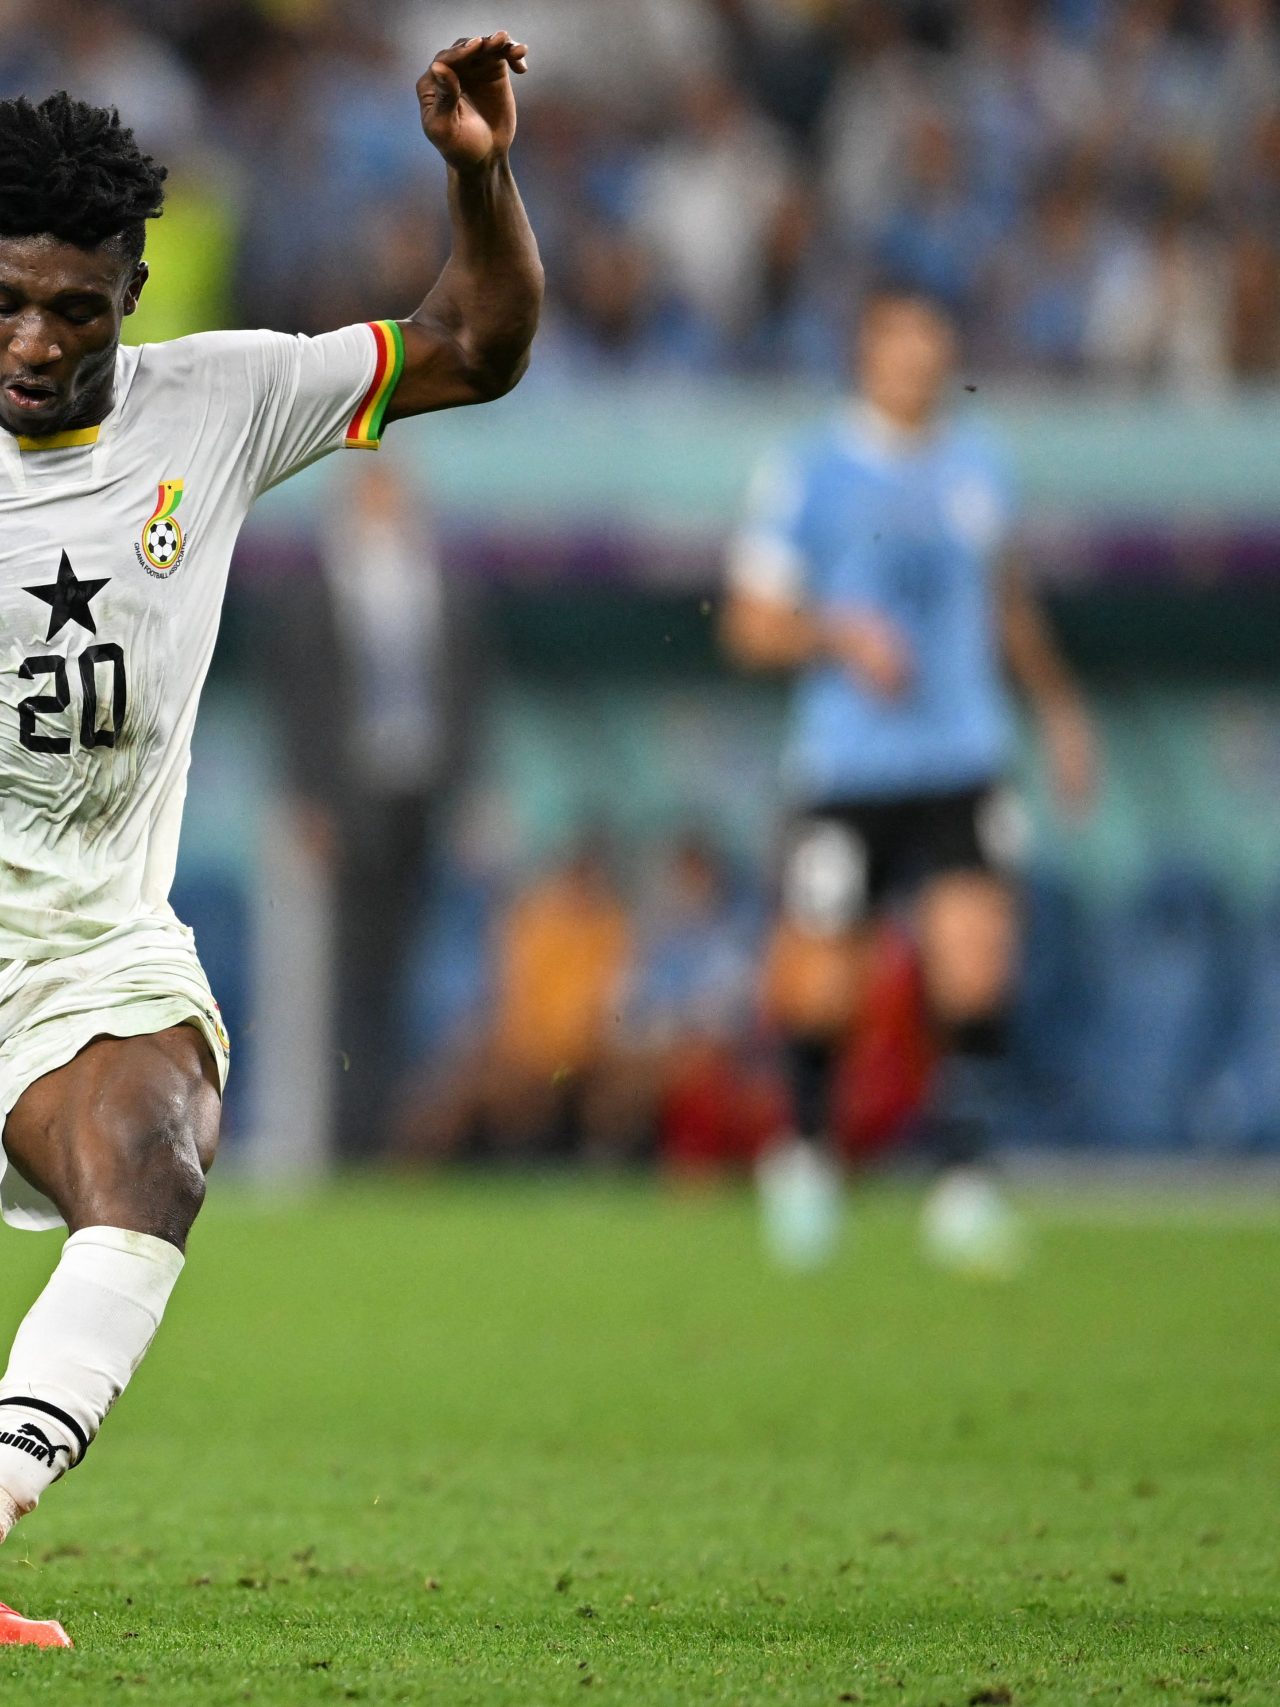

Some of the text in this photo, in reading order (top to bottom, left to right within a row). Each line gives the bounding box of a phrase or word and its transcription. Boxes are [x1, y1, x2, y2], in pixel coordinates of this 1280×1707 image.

[134, 542, 146, 568] GHANA
[144, 564, 169, 579] FOOTBALL
[17, 642, 127, 754] 20
